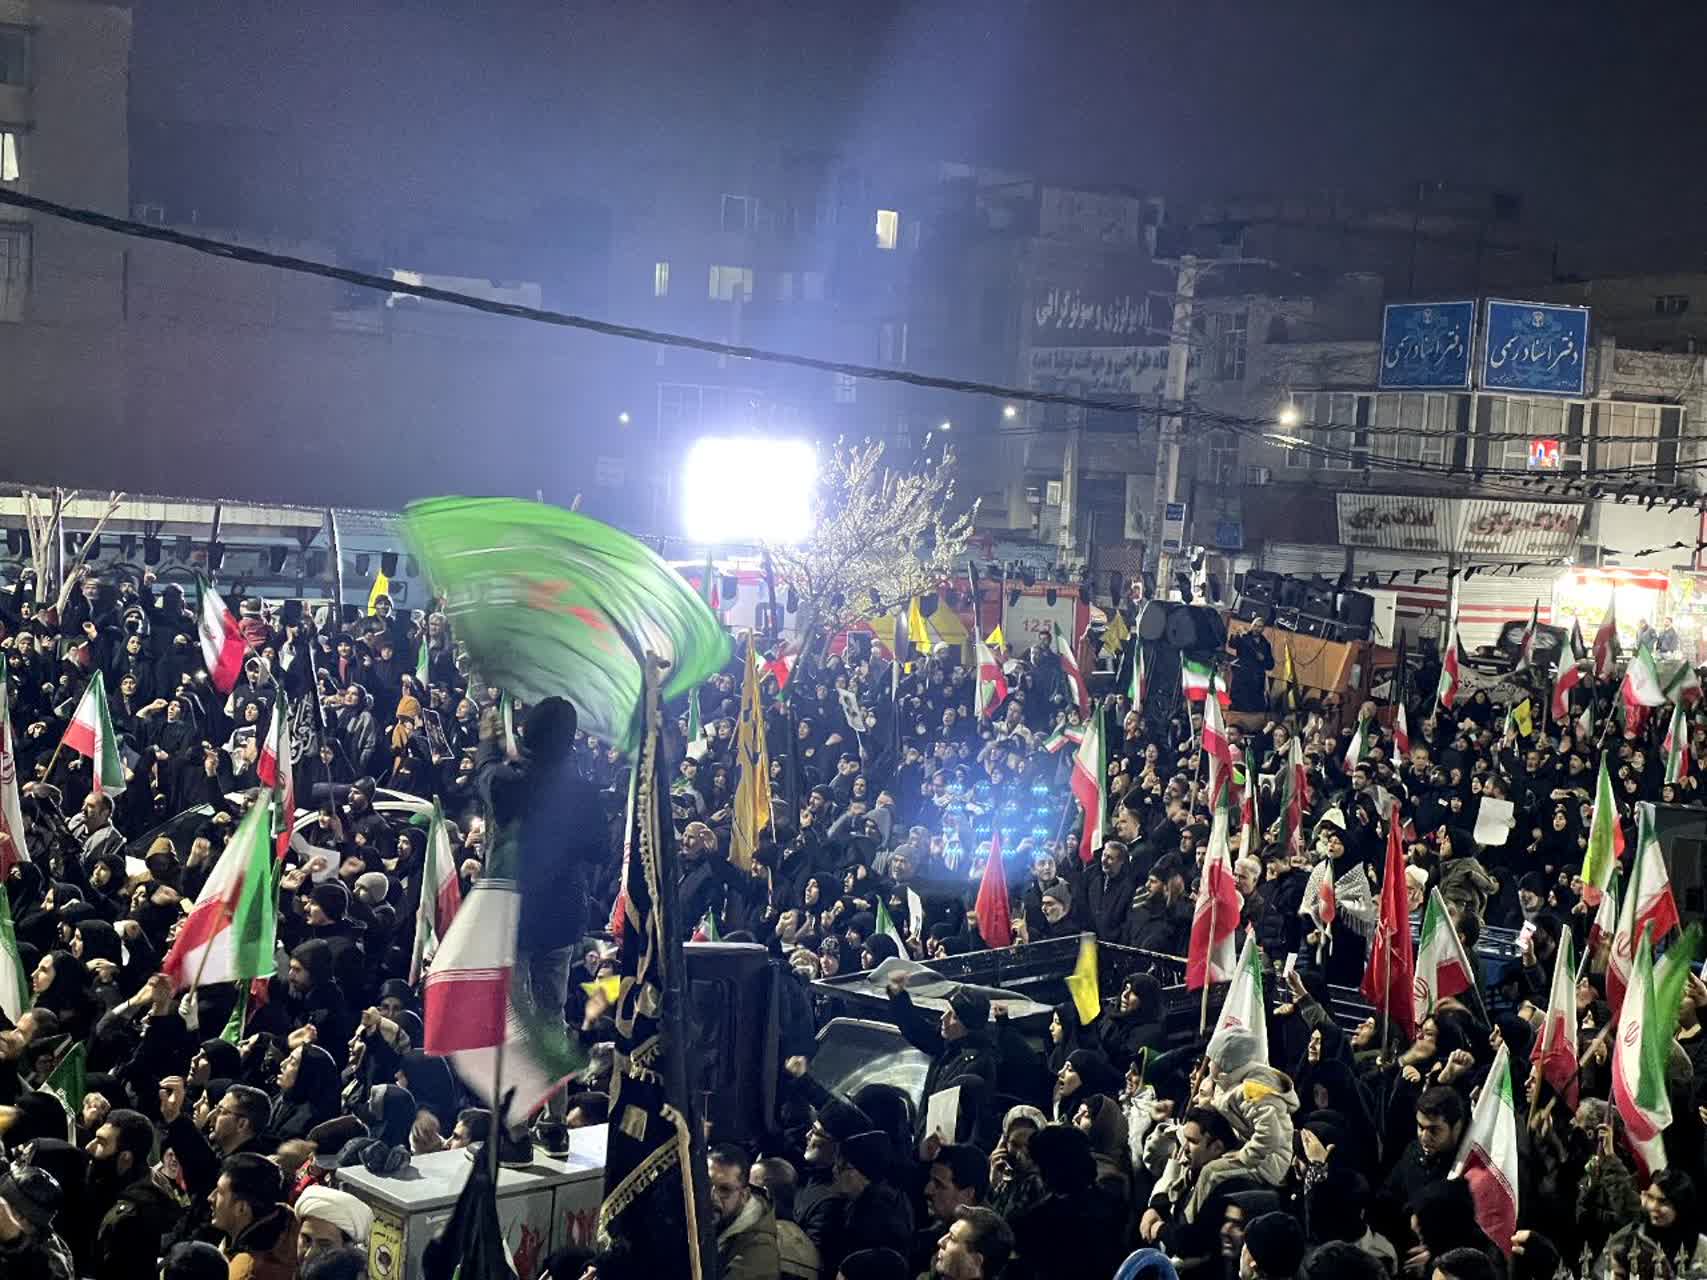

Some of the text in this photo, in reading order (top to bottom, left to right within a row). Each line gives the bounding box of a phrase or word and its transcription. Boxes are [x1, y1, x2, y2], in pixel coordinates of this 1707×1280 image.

[1413, 336, 1440, 361] اسناد
[1435, 323, 1464, 367] دفتر
[1490, 331, 1579, 371] دفتر اسناد رسمی
[1024, 618, 1052, 632] 125
